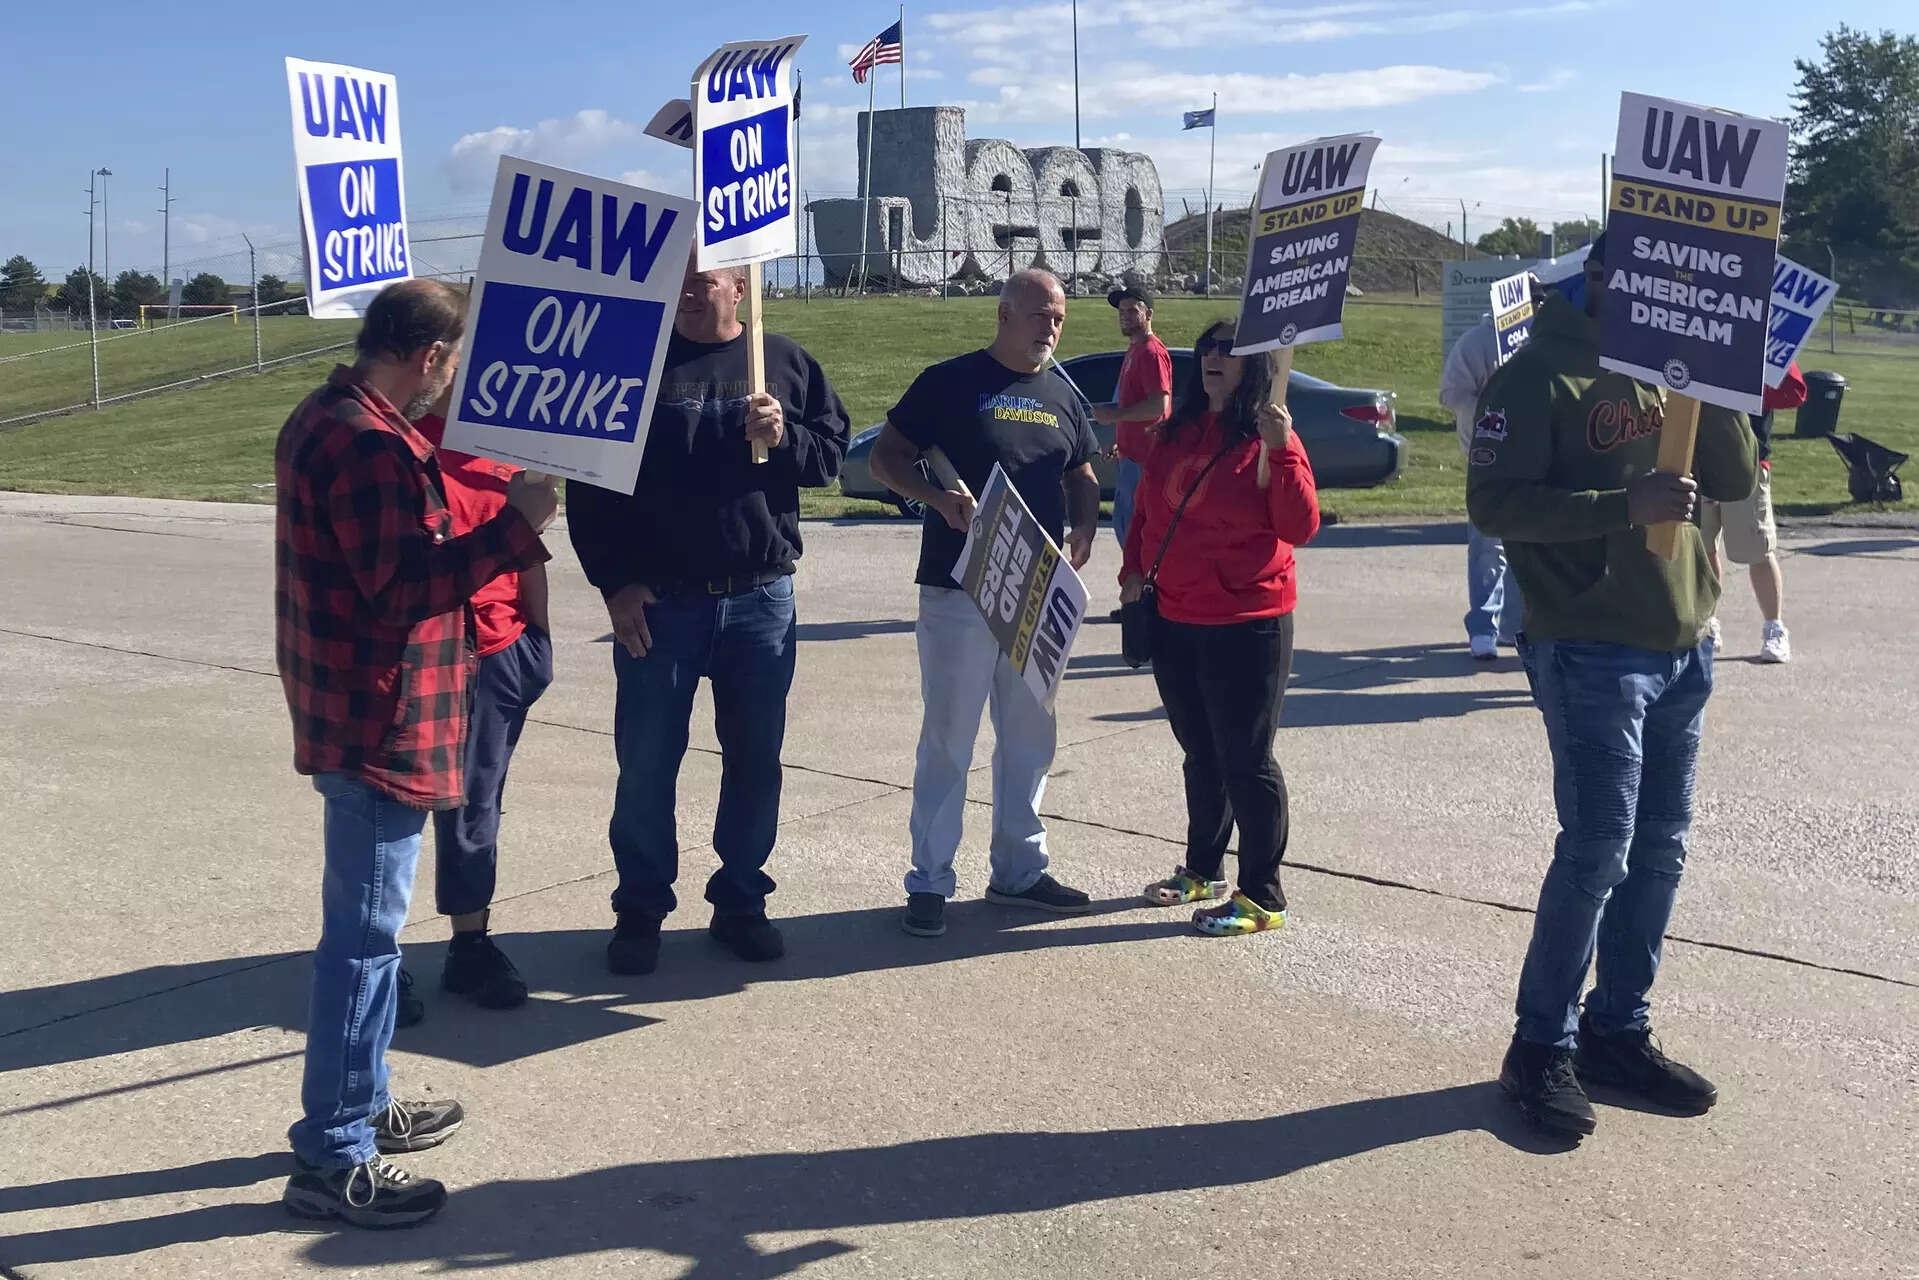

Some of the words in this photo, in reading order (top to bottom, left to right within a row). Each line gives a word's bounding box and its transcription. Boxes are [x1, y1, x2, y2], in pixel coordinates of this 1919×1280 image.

[708, 44, 794, 103] UAW
[298, 72, 387, 144] UAW
[730, 123, 762, 172] ON
[1281, 142, 1361, 196] UAW
[1642, 107, 1761, 189] UAW
[339, 165, 376, 218] ON
[708, 163, 789, 232] STRIKE
[1264, 203, 1327, 232] STAND
[1333, 195, 1358, 215] UP
[1619, 187, 1715, 223] STAND
[1726, 206, 1768, 231] UP
[323, 222, 405, 282] STRIKE
[502, 173, 679, 283] UAW
[1270, 232, 1340, 265] SAVING
[1250, 256, 1348, 296] AMERICAN
[1632, 236, 1742, 278] SAVING
[1674, 270, 1693, 281] THE
[1262, 281, 1328, 313] DREAM
[1499, 277, 1525, 309] UAW
[1608, 269, 1763, 322] AMERICAN
[526, 296, 601, 358] ON
[1501, 312, 1521, 328] STAND
[1507, 326, 1529, 347] COLA
[1630, 301, 1732, 345] DREAM
[470, 361, 643, 432] STRIKE
[995, 408, 1059, 428] DAVIDSON
[980, 504, 1022, 618] TIERS
[1000, 535, 1033, 623] END
[1024, 550, 1052, 627] STAND
[1016, 636, 1029, 662] UP
[1032, 587, 1078, 689] UAW
